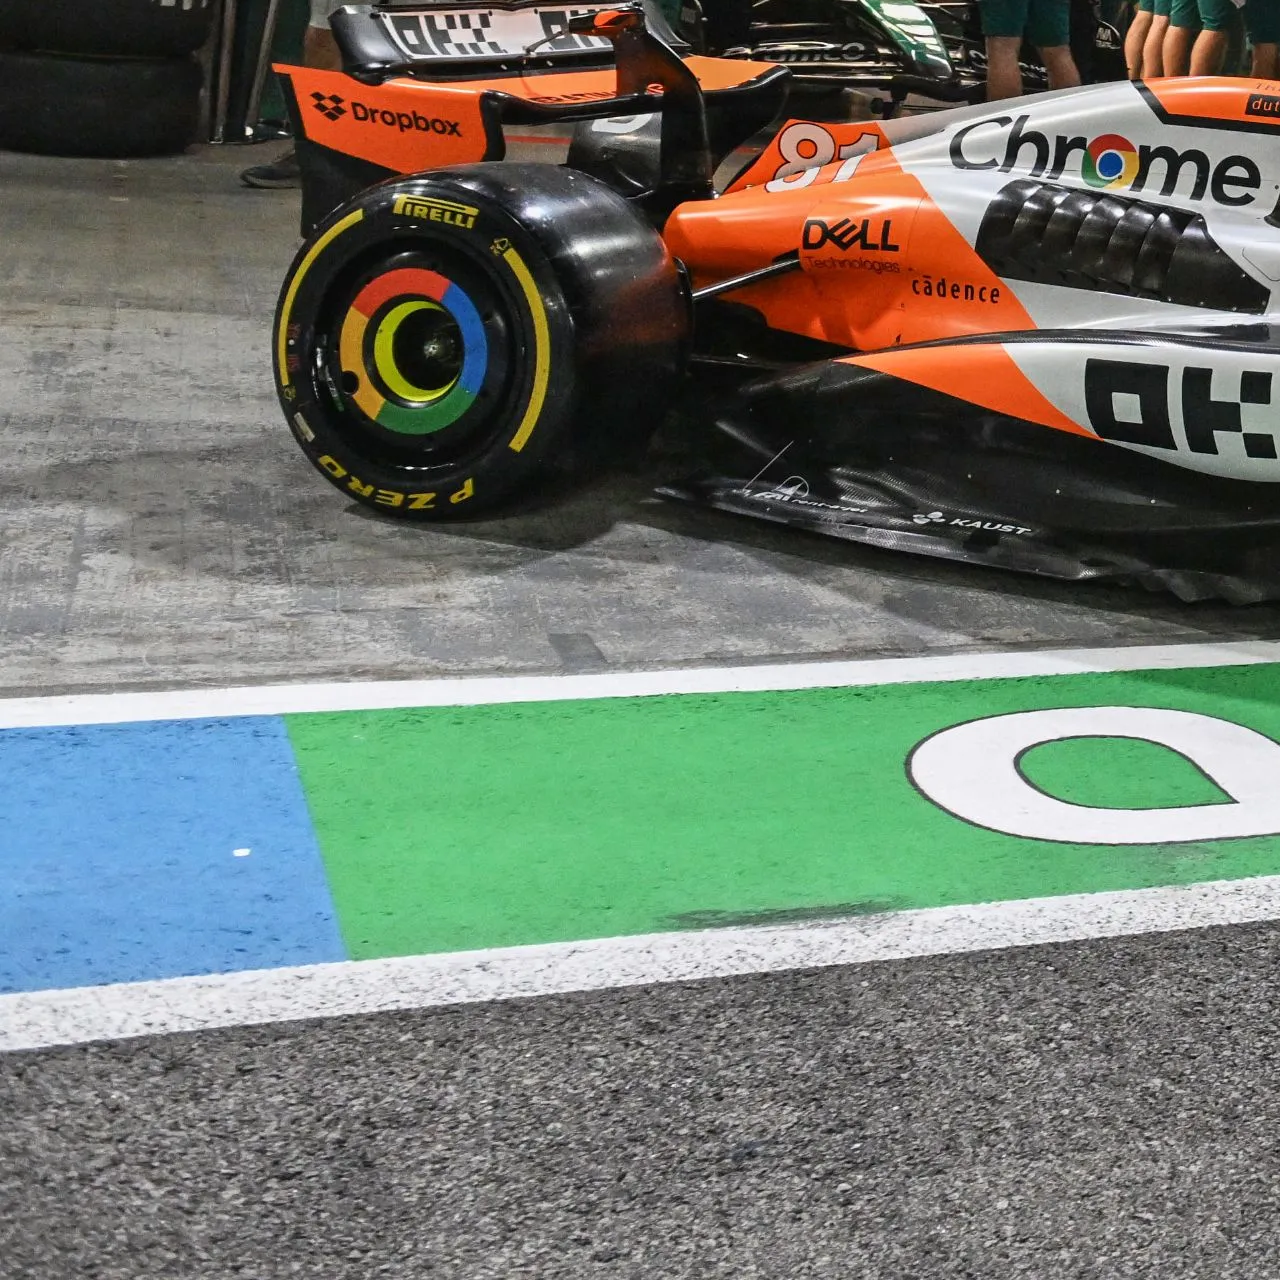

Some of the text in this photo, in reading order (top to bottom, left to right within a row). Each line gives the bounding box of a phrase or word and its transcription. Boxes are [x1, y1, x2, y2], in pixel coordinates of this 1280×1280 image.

[351, 102, 463, 138] Dropbox
[765, 122, 880, 193] 81
[949, 115, 1262, 207] Chrome
[393, 194, 480, 229] PIRELLI
[802, 218, 900, 251] DELL
[806, 256, 900, 275] Technologies
[318, 454, 437, 510] ZERO
[949, 517, 1034, 537] KAUST
